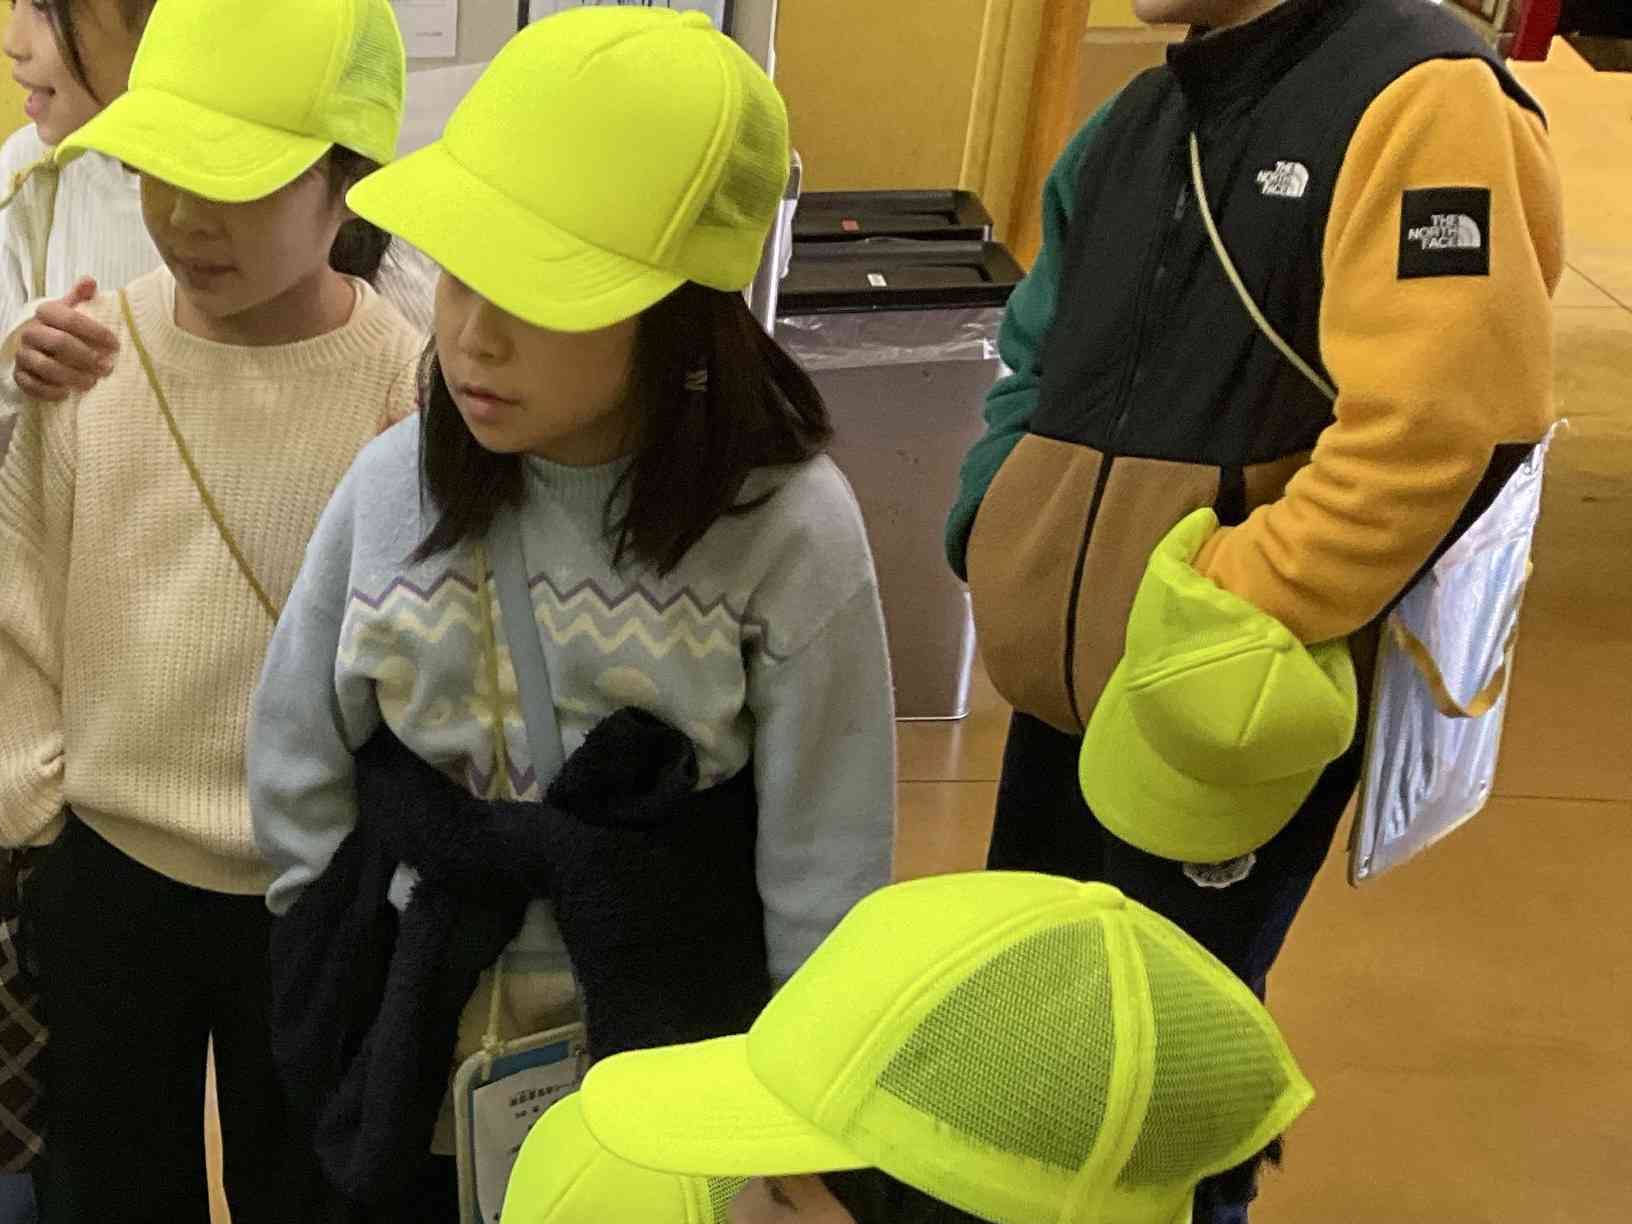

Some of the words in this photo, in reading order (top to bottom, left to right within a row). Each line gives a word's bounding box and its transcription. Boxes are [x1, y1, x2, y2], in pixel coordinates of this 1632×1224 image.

[1275, 161, 1295, 175] THE
[1256, 170, 1291, 186] NORTH
[1262, 183, 1289, 196] FACE
[1431, 213, 1457, 226] THE
[1408, 225, 1457, 241] NORTH
[1421, 237, 1457, 250] FACE
